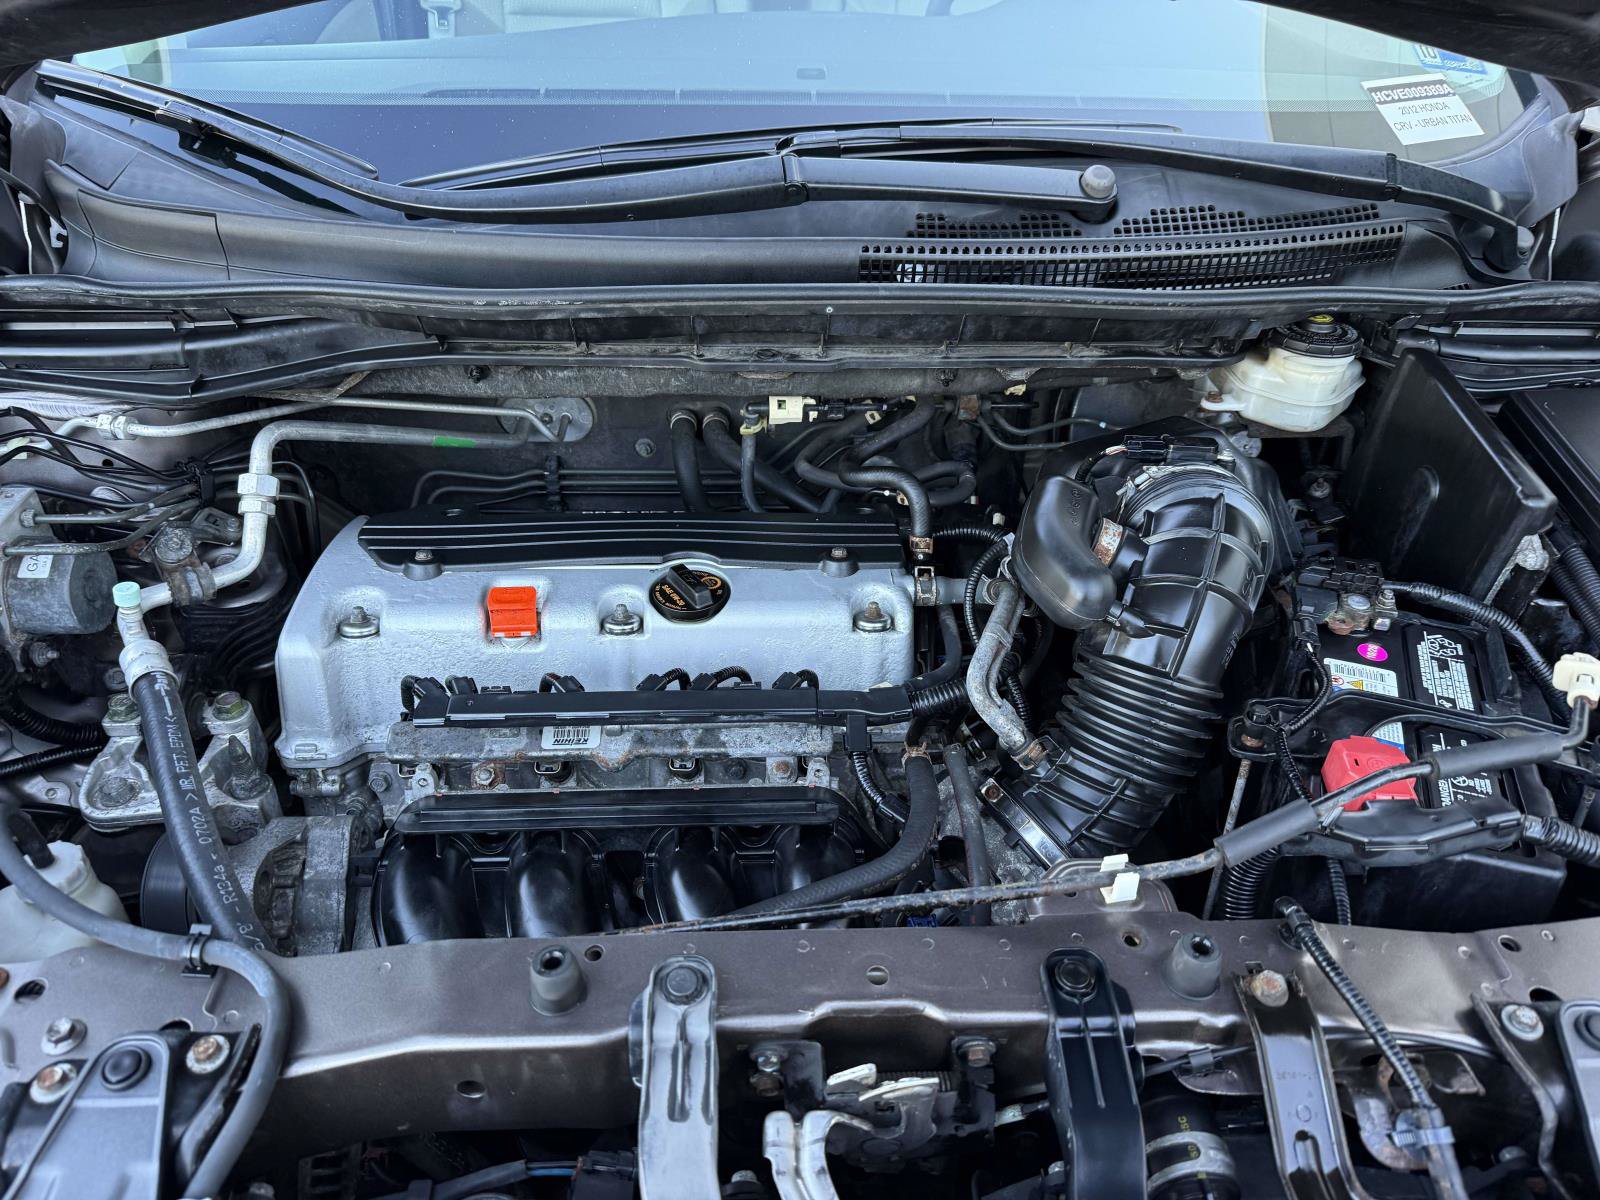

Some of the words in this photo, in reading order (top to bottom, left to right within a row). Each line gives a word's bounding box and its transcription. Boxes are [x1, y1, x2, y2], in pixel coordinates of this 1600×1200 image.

[1371, 84, 1455, 103] HCVE009389A
[1398, 105, 1419, 116] 2012
[1420, 101, 1450, 113] HONDA
[1393, 119, 1414, 132] CRV
[1417, 115, 1449, 128] URBAN
[1449, 112, 1473, 124] TITAN
[552, 738, 589, 746] KEIHIN
[190, 806, 214, 845] 0702A
[216, 864, 239, 905] R134a
